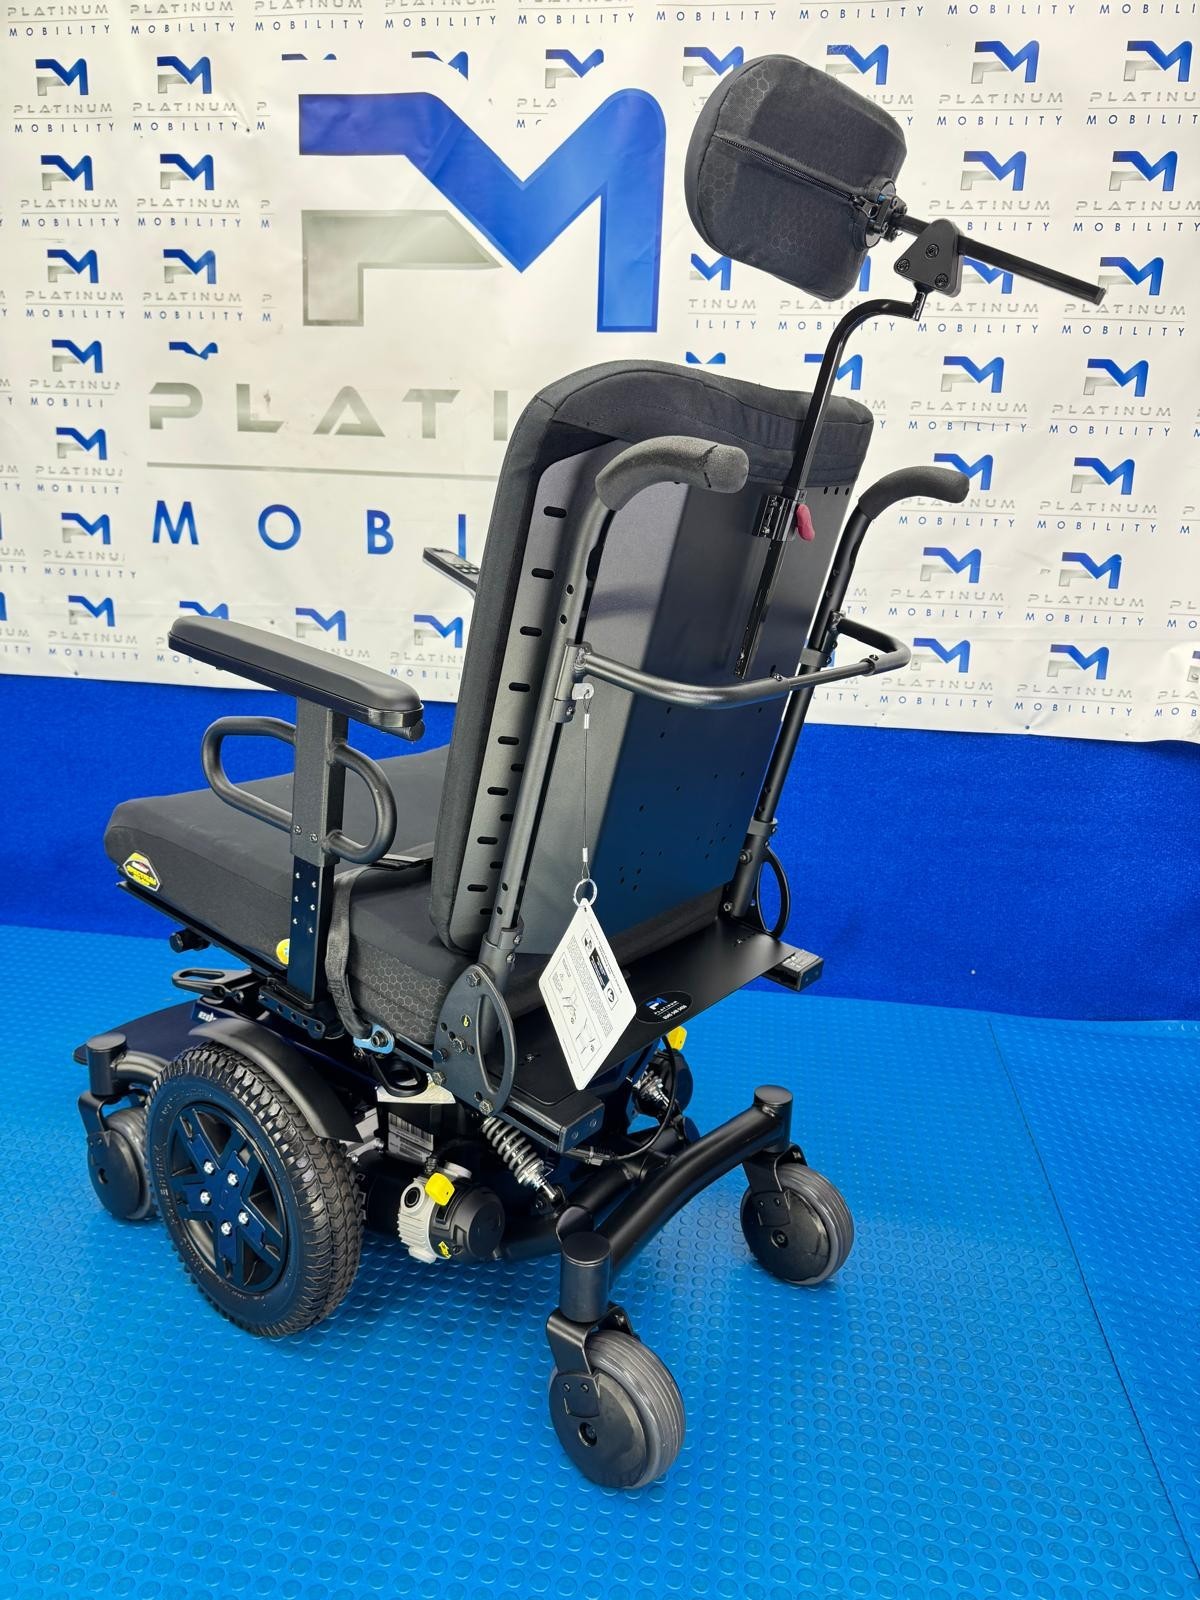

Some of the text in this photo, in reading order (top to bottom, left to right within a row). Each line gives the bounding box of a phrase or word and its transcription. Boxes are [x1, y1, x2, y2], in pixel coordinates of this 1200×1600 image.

[8, 4, 108, 16] PLATINUM
[130, 1, 233, 14] PLATINUM
[255, 0, 362, 10] PLATINUM
[948, 4, 1074, 15] MOBILITY
[1100, 3, 1195, 14] MOBILI
[657, 11, 776, 21] MOBILITY
[800, 6, 923, 19] MOBILITY
[385, 16, 495, 28] MOBILITY
[518, 13, 633, 24] MOBILITY
[9, 25, 109, 36] MOBILITY
[131, 23, 234, 34] MOBILITY
[255, 20, 363, 31] MOBILITY
[939, 92, 1063, 104] PLATINUM
[1090, 92, 1196, 102] PLATINU
[13, 103, 112, 113] PLATINUM
[133, 103, 236, 111] PLATINUM
[937, 116, 1062, 125] MOBILITY
[1087, 115, 1198, 124] MOBILIT
[15, 123, 113, 132] MOBILITY
[134, 122, 237, 131] MOBILITY
[21, 199, 117, 208] PLATINUM
[137, 198, 239, 208] PLATINUM
[929, 200, 1050, 210] PLATINUM
[1076, 201, 1200, 210] PLATINUM
[22, 218, 119, 227] MOBILITY
[138, 218, 240, 226] MOBILITY
[968, 222, 1049, 231] BILITY
[1073, 222, 1200, 231] MOBILITY
[26, 291, 123, 300] PLATINUM
[143, 292, 241, 301] PLATINUM
[689, 299, 755, 309] TINUM
[780, 299, 859, 310] PLATIN
[1065, 301, 1185, 315] PLATINUM
[26, 309, 124, 318] MOBILITY
[144, 311, 242, 320] MOBILITY
[696, 320, 756, 329] ILITY
[778, 321, 895, 331] MOBIITY
[918, 323, 1038, 333] MOBILITY
[1062, 325, 1184, 336] MOBILITY
[31, 397, 103, 408] MOBILI
[911, 401, 1027, 412] PLATINUM
[149, 382, 508, 441] PLATI
[1052, 405, 1171, 416] PLATINUM
[909, 421, 1026, 432] MOBILITY
[1049, 425, 1170, 436] MOBILITY
[36, 466, 122, 476] PLATINU
[37, 484, 118, 493] MOBILIT
[900, 497, 1015, 509] PLANUM
[1040, 501, 1157, 513] PLATINUM
[899, 516, 1014, 527] MOBILITY
[1037, 521, 1156, 532] MOBILITY
[152, 500, 467, 560] MOBI
[44, 549, 124, 561] PLATINU
[45, 568, 135, 577] MOBILITY
[891, 589, 1003, 600] PLATINUM
[1028, 594, 1144, 608] PLATINUM
[889, 608, 1003, 619] MOBILITY
[1026, 613, 1143, 626] MOBILITY
[49, 631, 136, 643] PLATINUM
[49, 649, 138, 659] MOBILITY
[391, 652, 463, 664] PLATIN
[390, 668, 461, 680] MOBILI
[881, 678, 992, 691] PLATINUM
[1016, 684, 1132, 699] PLATINUM
[880, 696, 992, 707] MOBILITY
[1015, 702, 1132, 716] MOBILITY
